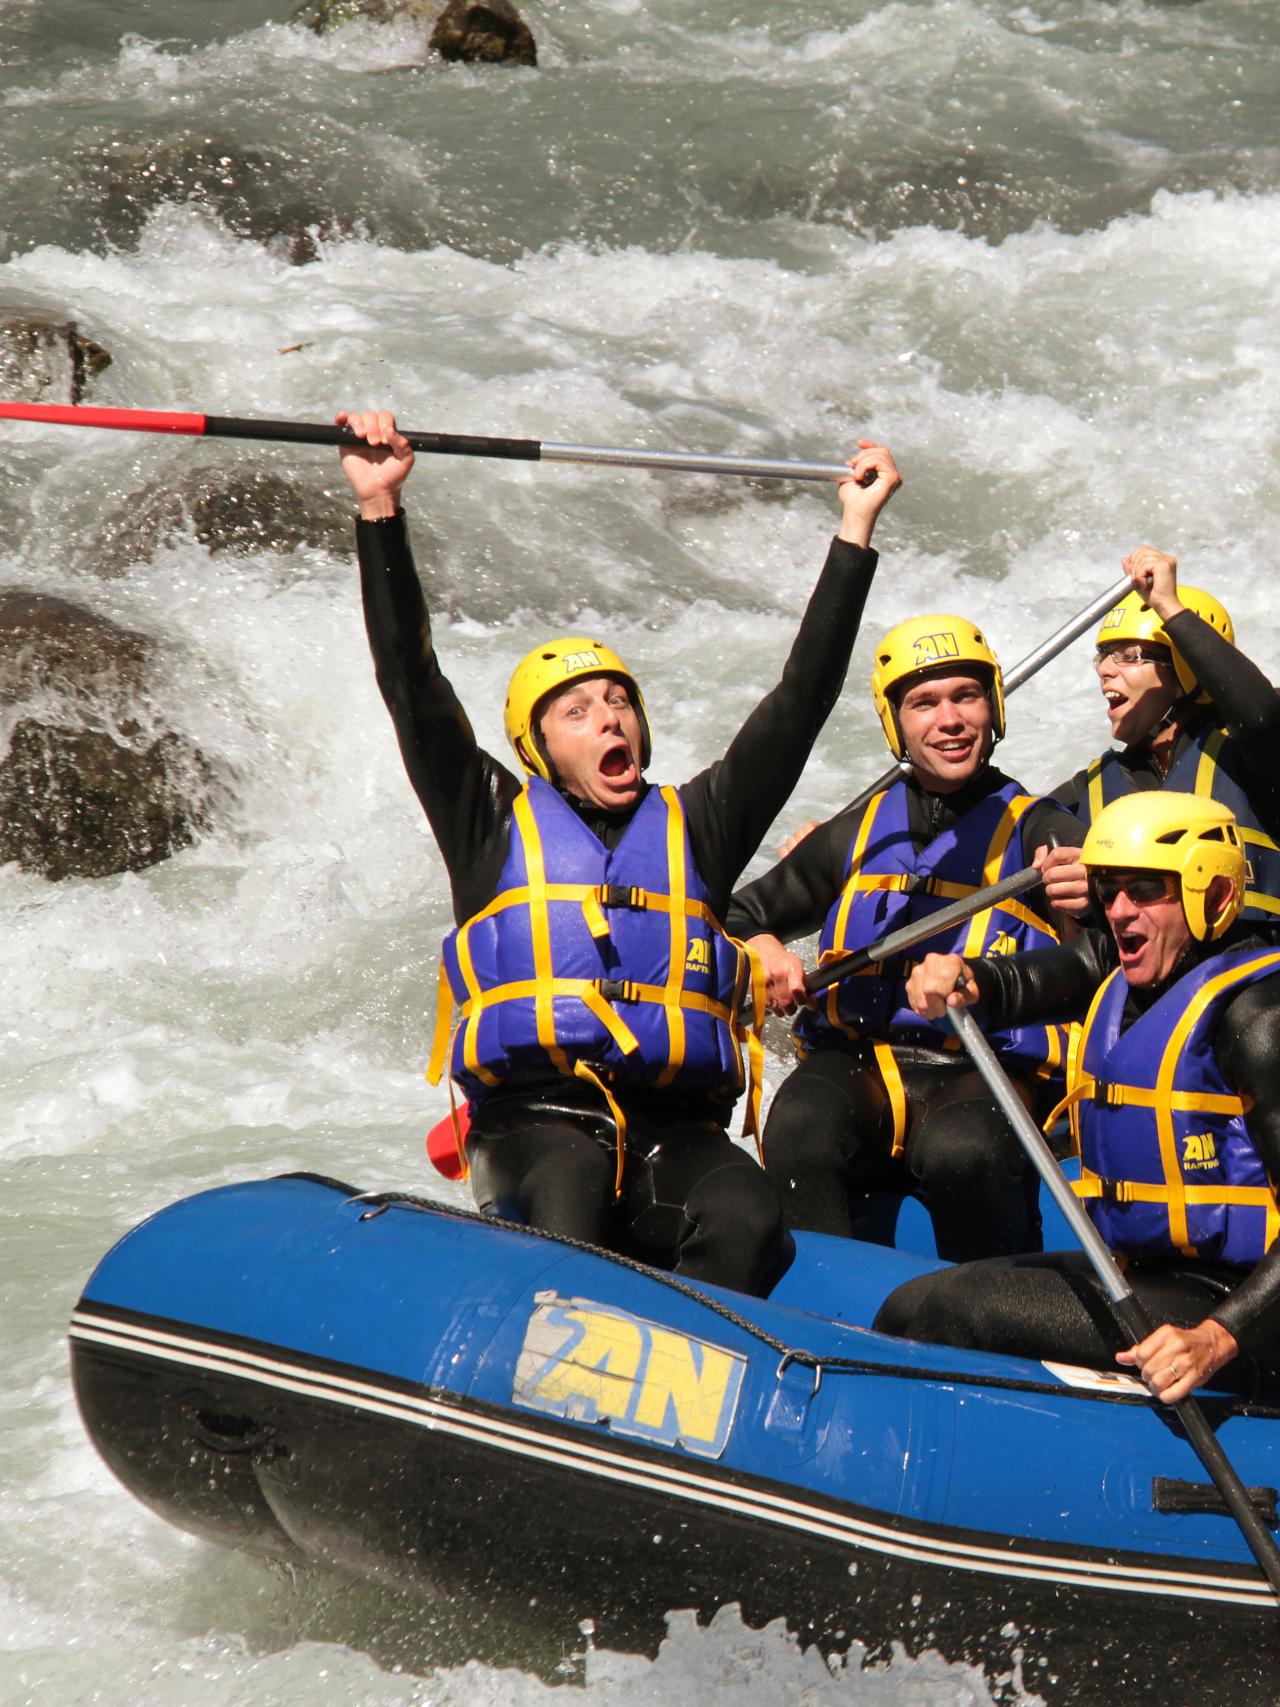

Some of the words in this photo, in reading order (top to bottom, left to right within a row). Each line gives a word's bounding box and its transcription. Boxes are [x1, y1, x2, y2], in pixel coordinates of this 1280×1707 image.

[563, 651, 601, 673] AN
[913, 633, 959, 665] AN
[1183, 1133, 1215, 1162] AN
[530, 1306, 738, 1446] AN
